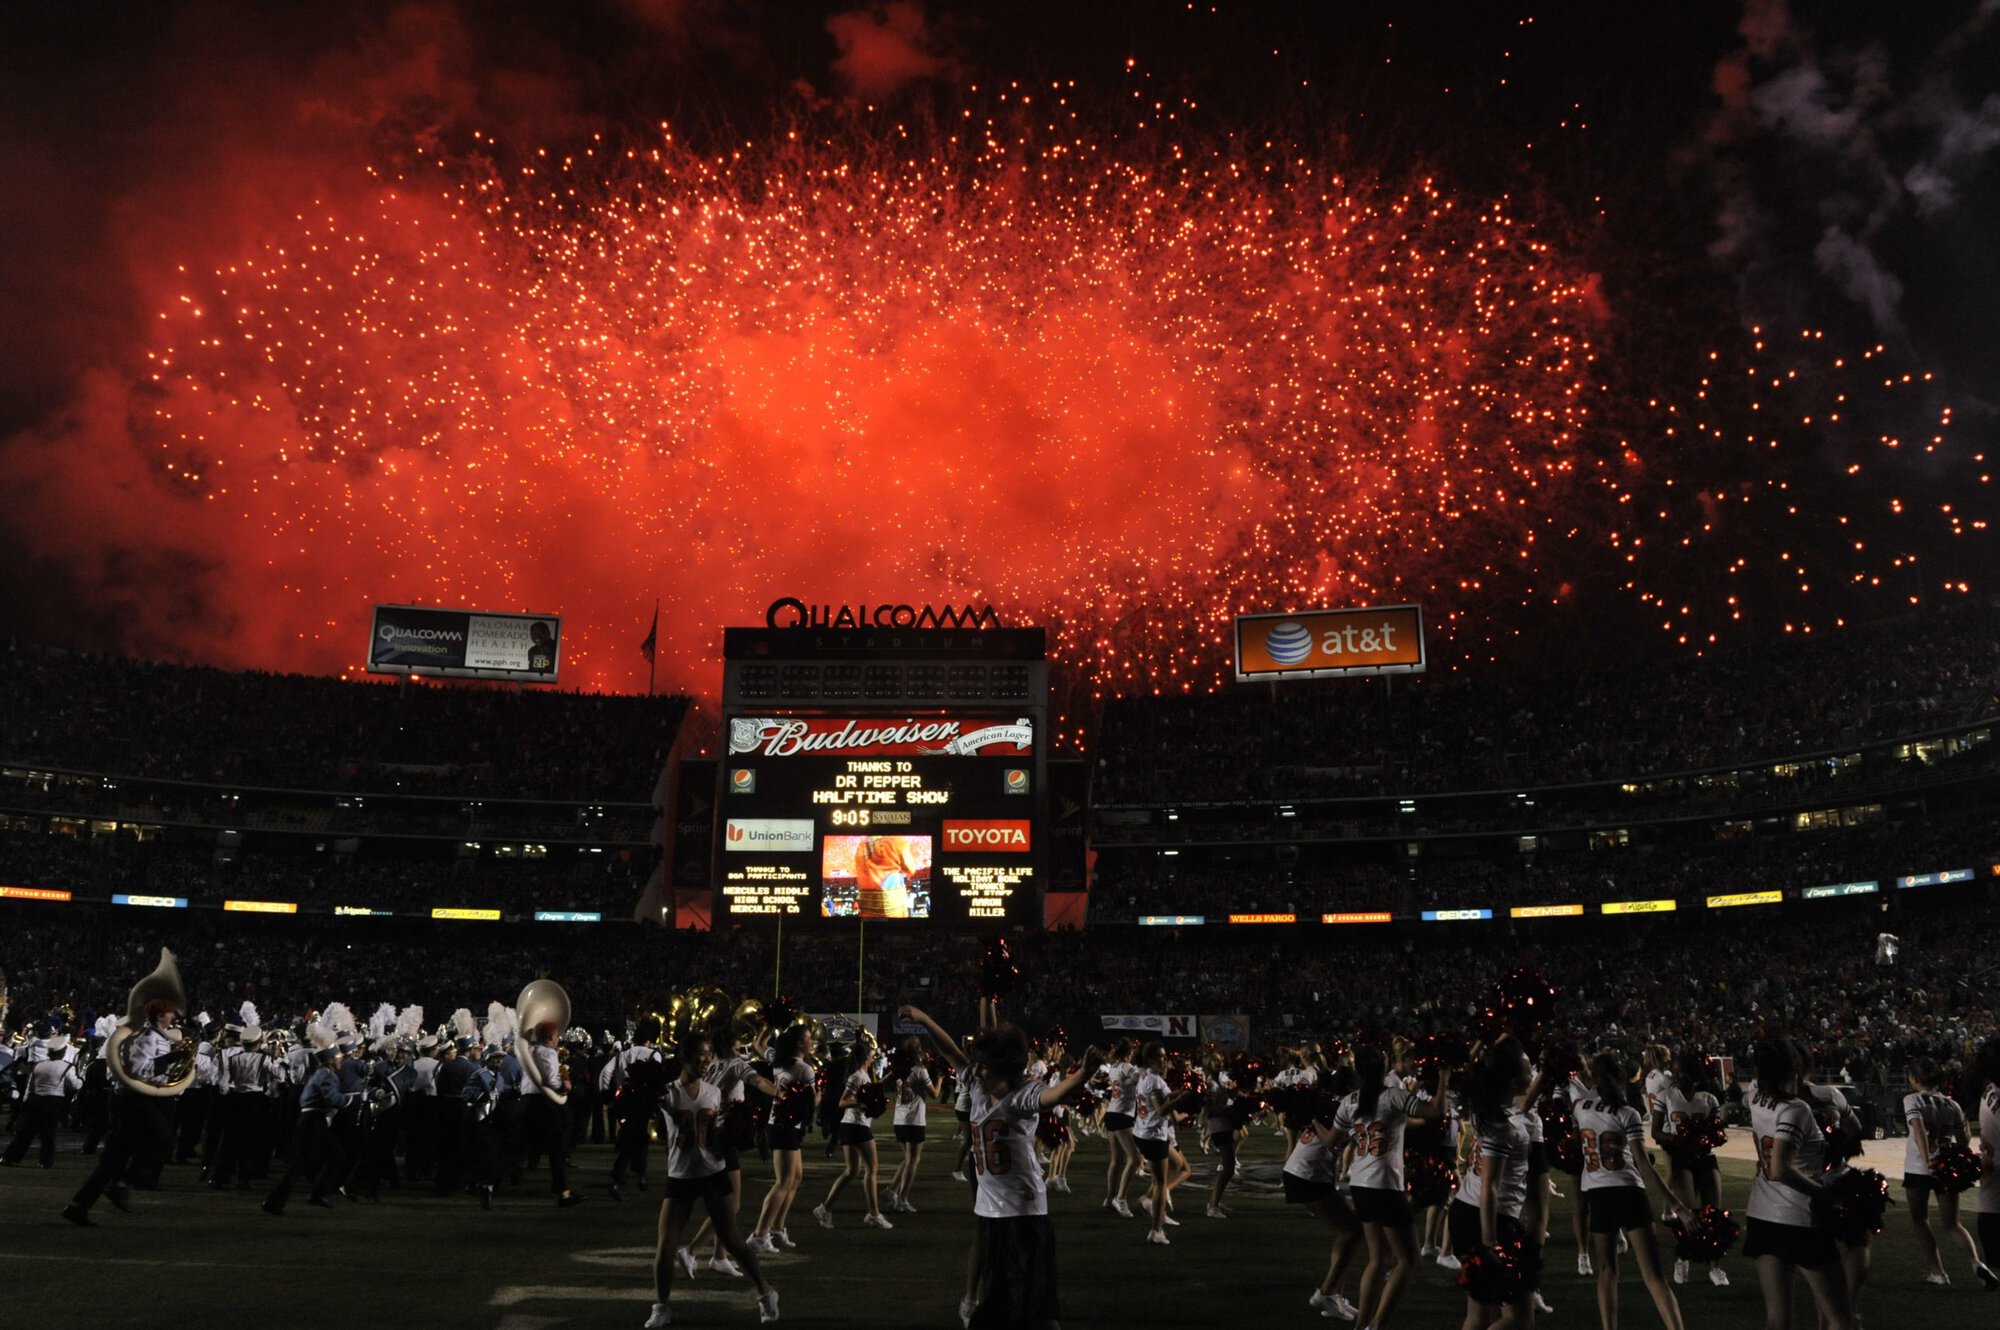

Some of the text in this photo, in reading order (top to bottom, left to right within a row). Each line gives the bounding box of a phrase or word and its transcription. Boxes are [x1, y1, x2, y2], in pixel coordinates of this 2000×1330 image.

[766, 597, 1002, 628] QUALCOMM
[472, 620, 529, 631] PALOMAR
[380, 625, 462, 642] QUALCOMM
[472, 630, 529, 640] POMERADO
[1321, 622, 1397, 655] at&t
[471, 640, 528, 650] HEALTH
[474, 659, 521, 668] www.pph.org
[756, 718, 960, 756] Budweiser
[962, 730, 1031, 750] American Lager
[847, 762, 912, 772] THANKS TO
[835, 775, 922, 788] DR PEPPER
[813, 791, 949, 803] HALFTIME SHOW
[832, 810, 870, 825] 9:05
[873, 813, 910, 821] SYCUAN
[749, 831, 812, 841] UnionBank
[947, 829, 1026, 844] TOYOTA
[942, 867, 1033, 876] THE PACIFIC LIFE
[952, 875, 1021, 883] HOLIDAY BOWL
[723, 886, 809, 895] HERCULES MIDDLE
[734, 896, 797, 904] HIGH SCHOOL
[232, 902, 290, 913] CYMER
[787, 905, 800, 913] CA
[969, 908, 1005, 917] MILLER
[1521, 906, 1574, 917] CYMER
[1230, 914, 1295, 923] WELLS FARGO
[1436, 910, 1481, 920] GEICO
[1169, 1017, 1189, 1034] N
[1582, 1100, 1618, 1115] BGA
